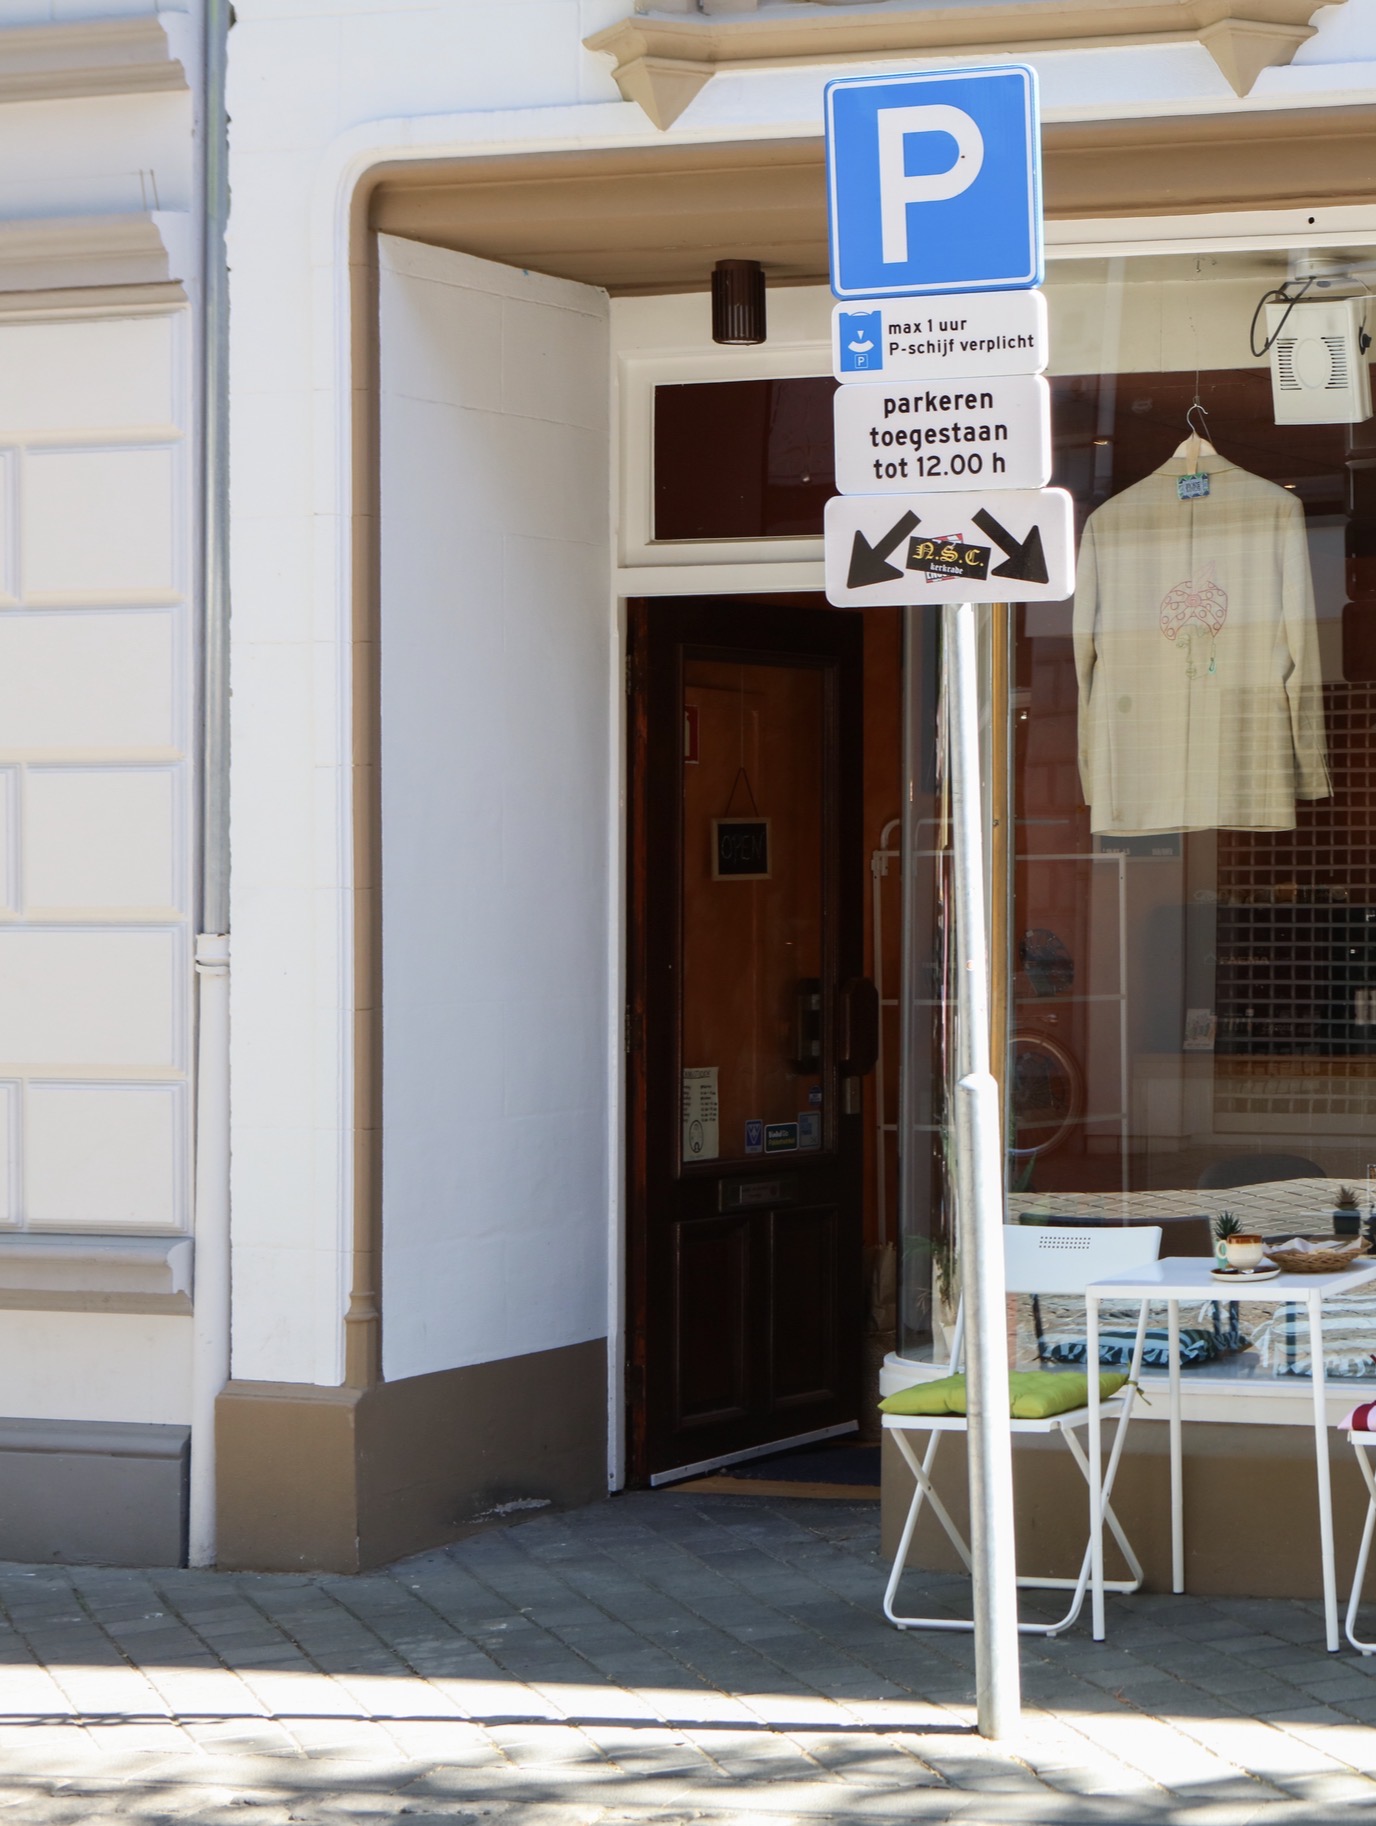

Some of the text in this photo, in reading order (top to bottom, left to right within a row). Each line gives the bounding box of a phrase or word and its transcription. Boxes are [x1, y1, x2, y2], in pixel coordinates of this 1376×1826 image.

[877, 103, 984, 264] P
[888, 319, 967, 334] max 1 uur
[889, 334, 1034, 357] P-schijf verplicht
[883, 391, 994, 419] parkeren
[869, 422, 1008, 452] toegestaan
[873, 452, 1006, 480] tot 12.00 h
[930, 563, 964, 577] kerkrade
[720, 832, 765, 864] OPEN
